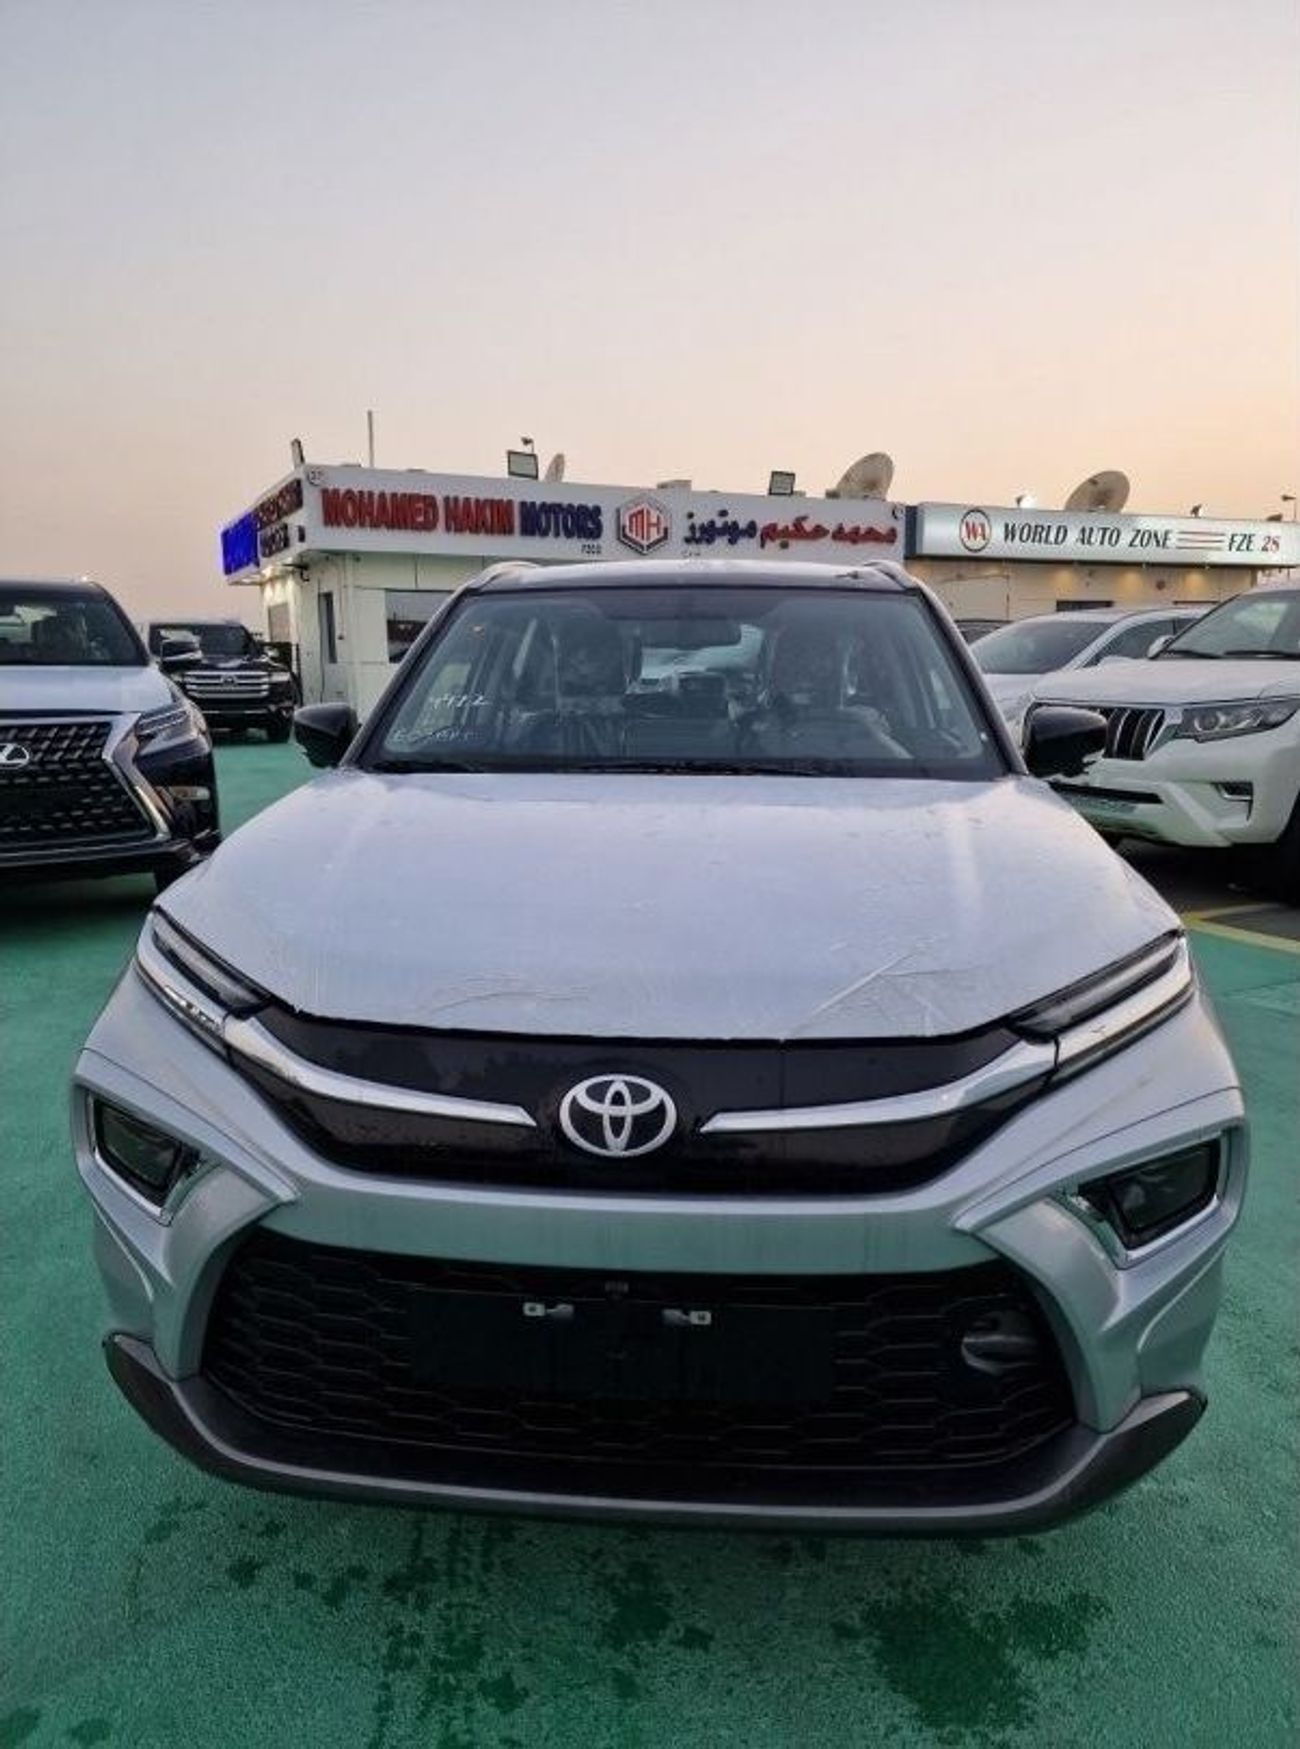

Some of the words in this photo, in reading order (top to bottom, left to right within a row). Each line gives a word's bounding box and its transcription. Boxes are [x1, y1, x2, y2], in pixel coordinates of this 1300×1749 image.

[321, 487, 439, 532] MOHAMED
[443, 495, 515, 536] HAKIM
[519, 501, 602, 540] MOTORS
[760, 515, 830, 550] حكيم
[832, 519, 898, 545] محمد
[1003, 522, 1068, 546] WORLD
[1075, 525, 1121, 548] AUTO
[1128, 529, 1172, 549] ZONE
[1228, 533, 1255, 552] FZE
